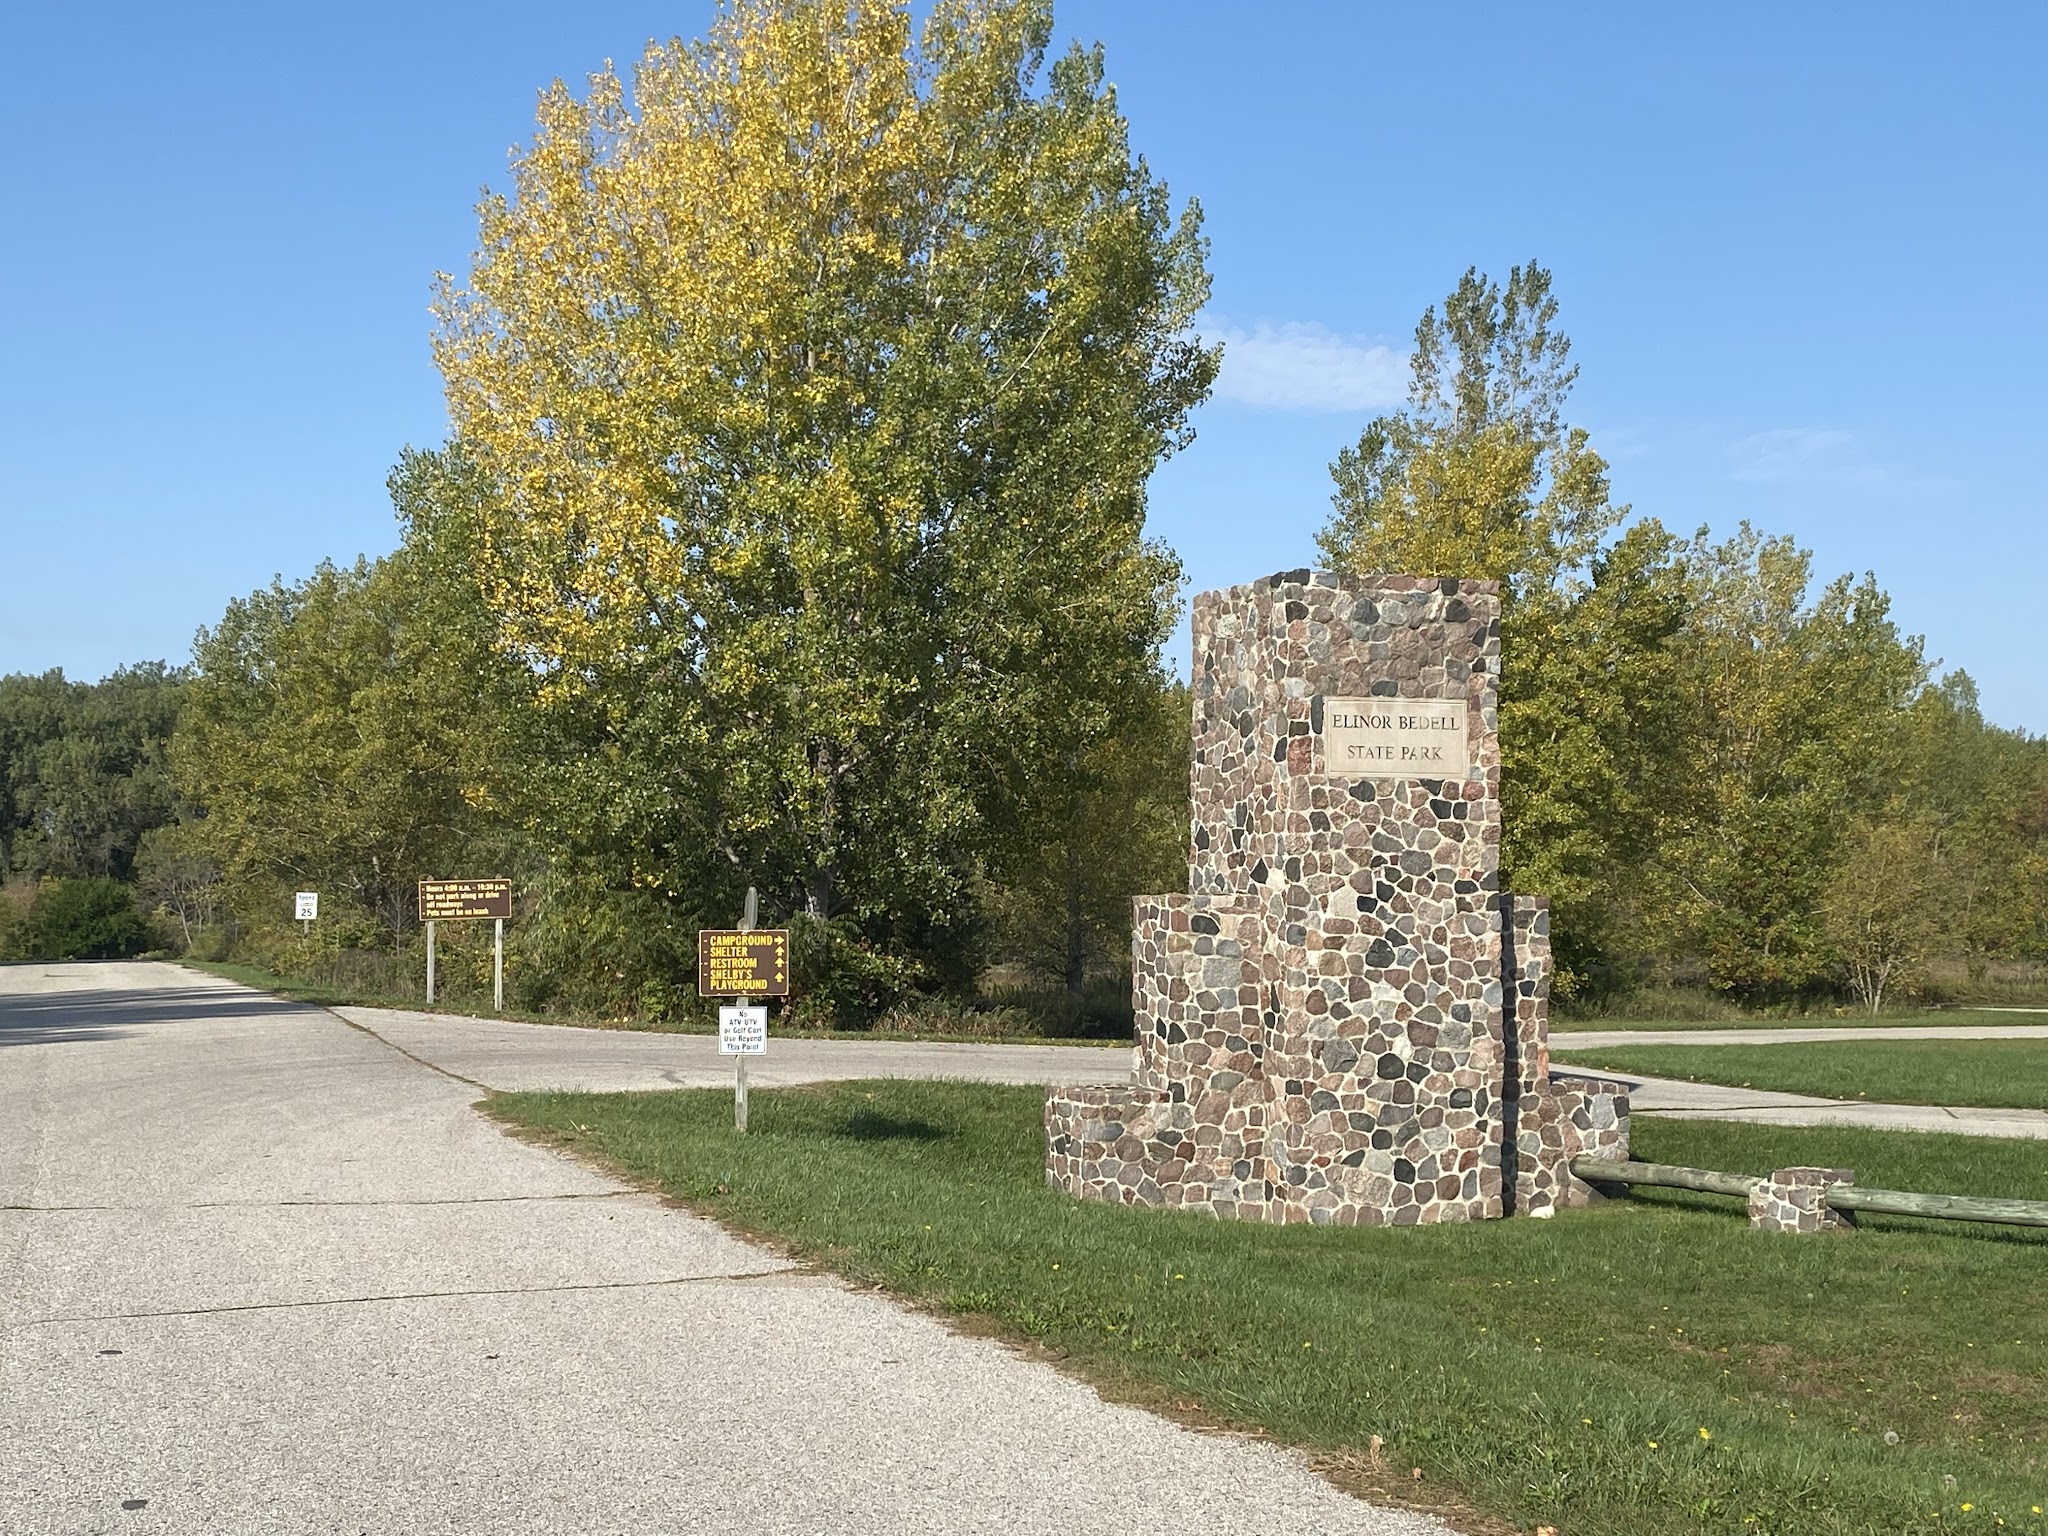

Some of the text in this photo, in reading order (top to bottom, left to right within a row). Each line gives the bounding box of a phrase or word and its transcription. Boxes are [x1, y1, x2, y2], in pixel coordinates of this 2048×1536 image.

[1332, 714, 1460, 731] ELINOR BEDELL
[1347, 745, 1443, 760] STATE PARK
[446, 893, 459, 902] park
[460, 892, 477, 900] along
[301, 908, 312, 917] 25
[710, 936, 773, 946] CAMPGROUND
[710, 946, 748, 957] SHELTER
[710, 958, 757, 969] RESTROOM
[710, 970, 753, 980] SHELBY'S
[710, 979, 768, 990] PLAYGROUND
[738, 1035, 762, 1043] Beyond
[727, 1043, 759, 1051] This Point
